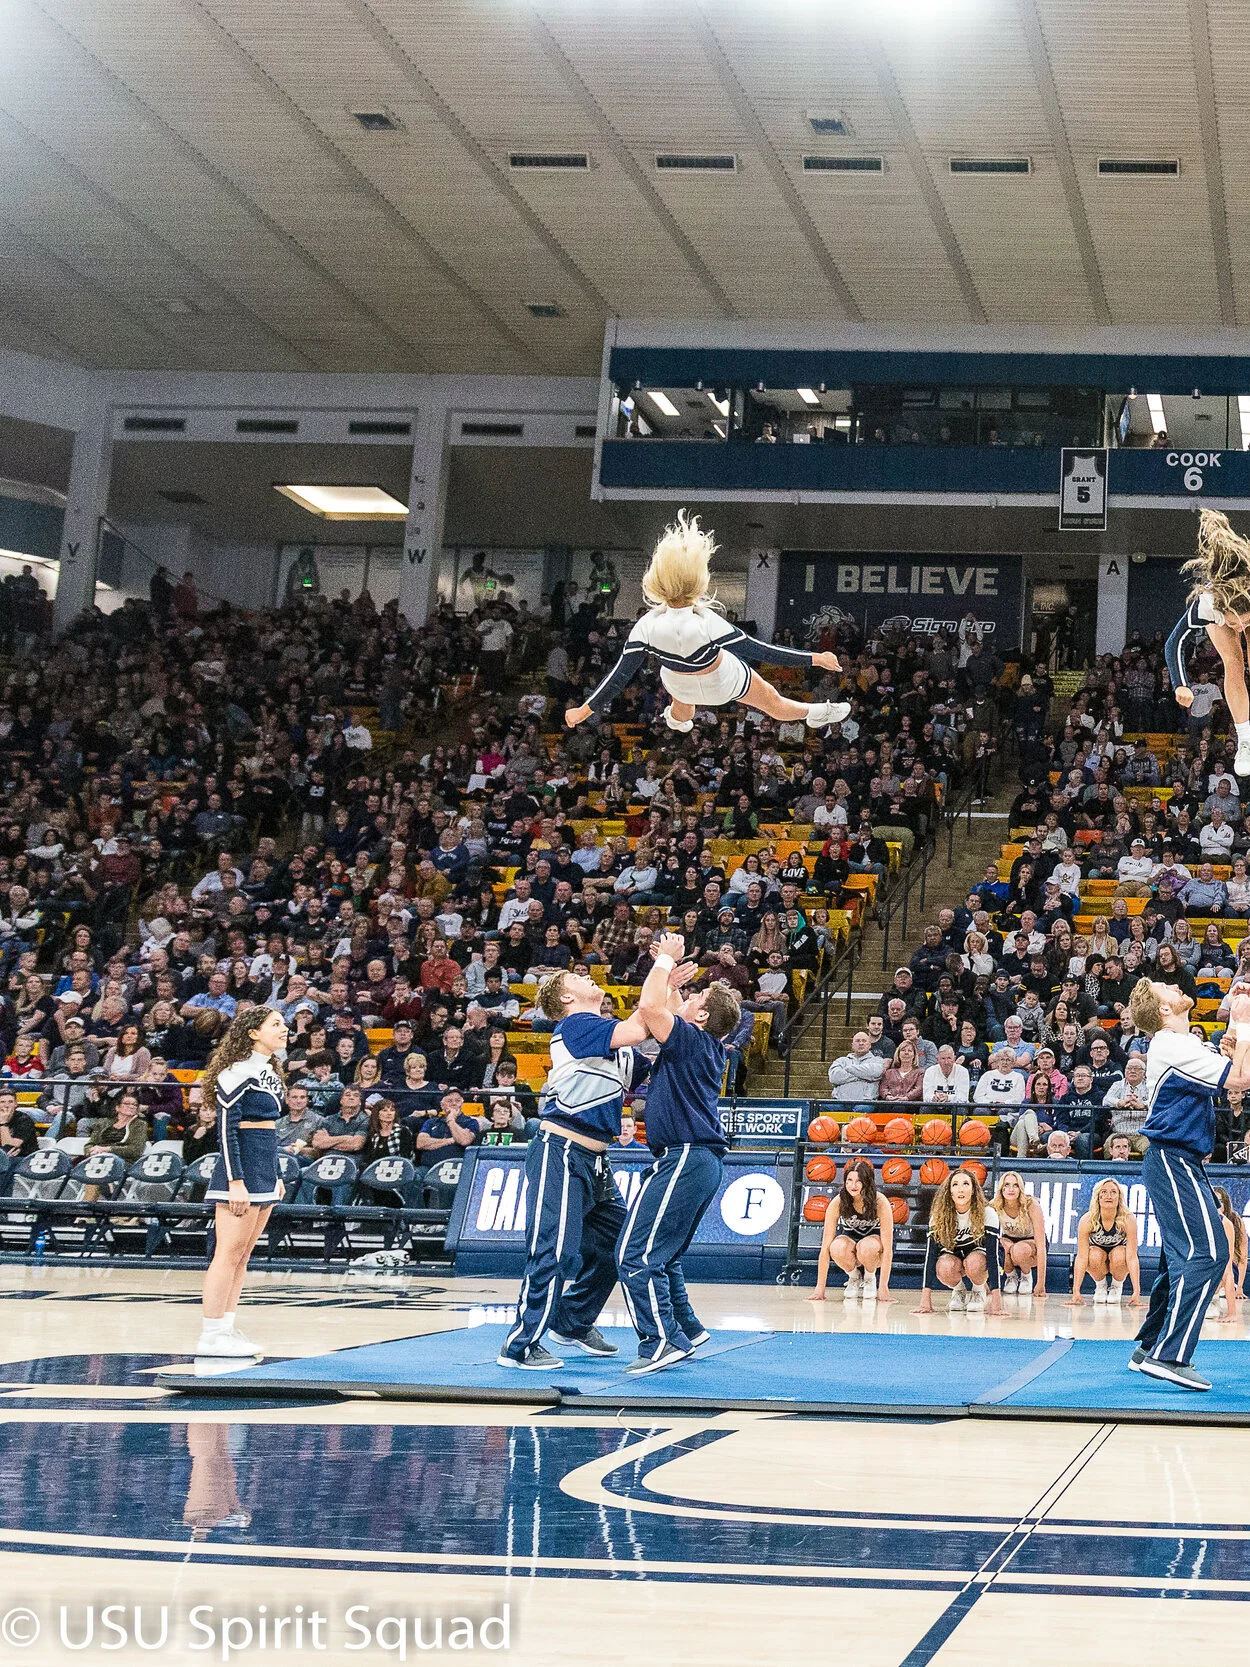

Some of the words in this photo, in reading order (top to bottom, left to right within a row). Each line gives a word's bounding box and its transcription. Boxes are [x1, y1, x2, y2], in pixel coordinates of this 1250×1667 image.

[1166, 452, 1221, 467] COOK
[1183, 468, 1203, 491] 6
[1077, 486, 1090, 503] 5
[407, 549, 427, 564] W
[756, 553, 771, 568] X
[1106, 561, 1120, 575] A
[805, 565, 815, 592] I
[837, 564, 999, 595] BELIEVE
[782, 867, 806, 878] LOVE
[747, 1112, 796, 1124] SPORTS
[743, 1187, 766, 1219] F
